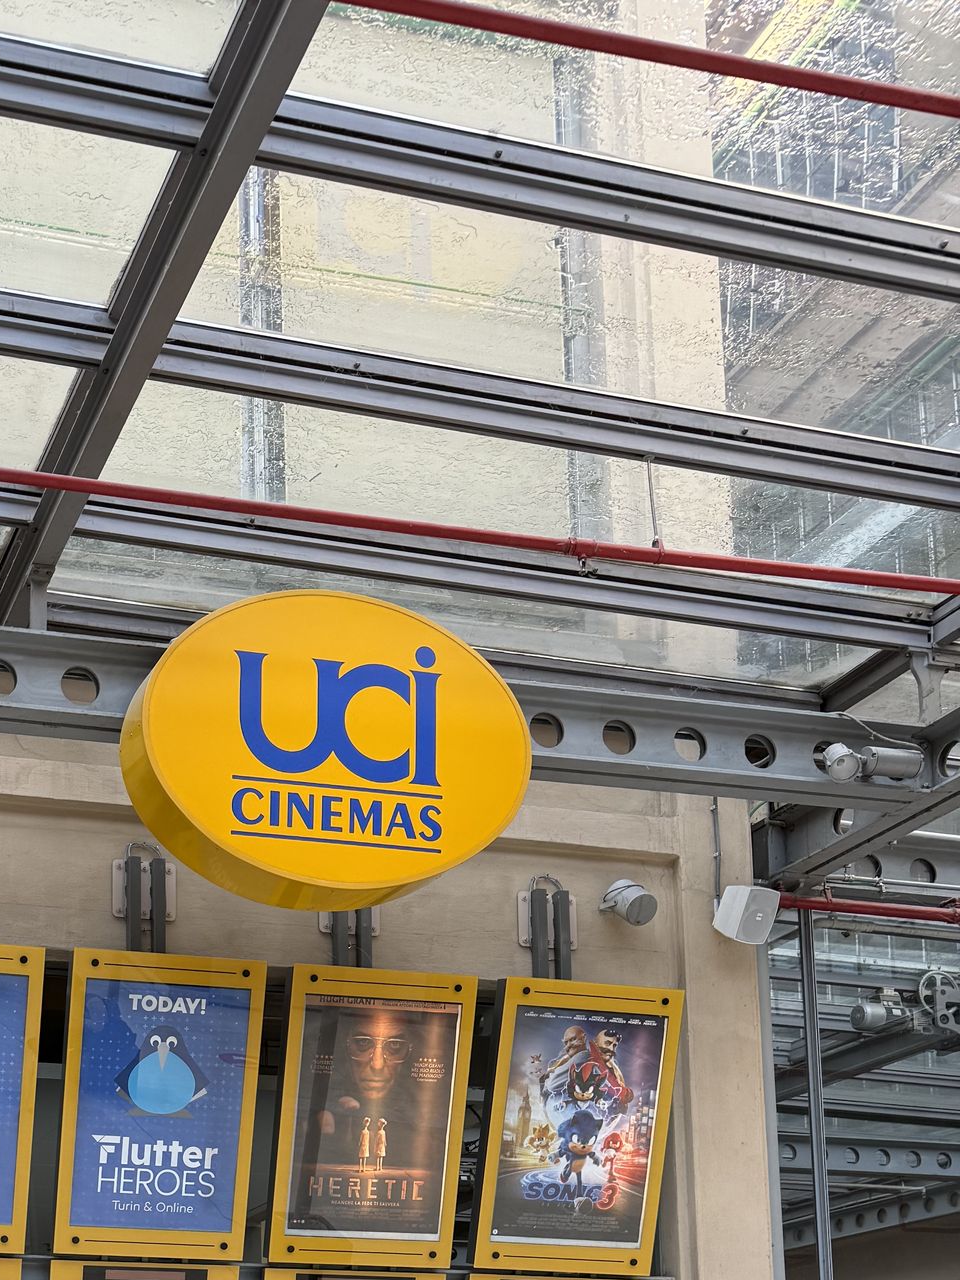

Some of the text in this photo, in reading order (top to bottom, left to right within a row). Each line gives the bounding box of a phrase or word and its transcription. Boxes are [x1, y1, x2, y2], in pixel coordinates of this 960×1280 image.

[231, 787, 442, 841] CINEMAS
[128, 993, 207, 1015] TODAY!
[91, 1134, 219, 1170] Flutter
[97, 1166, 216, 1198] HEROES
[308, 1175, 426, 1201] HERETIC
[596, 1182, 621, 1210] 3
[111, 1200, 194, 1214] Turin & Online
